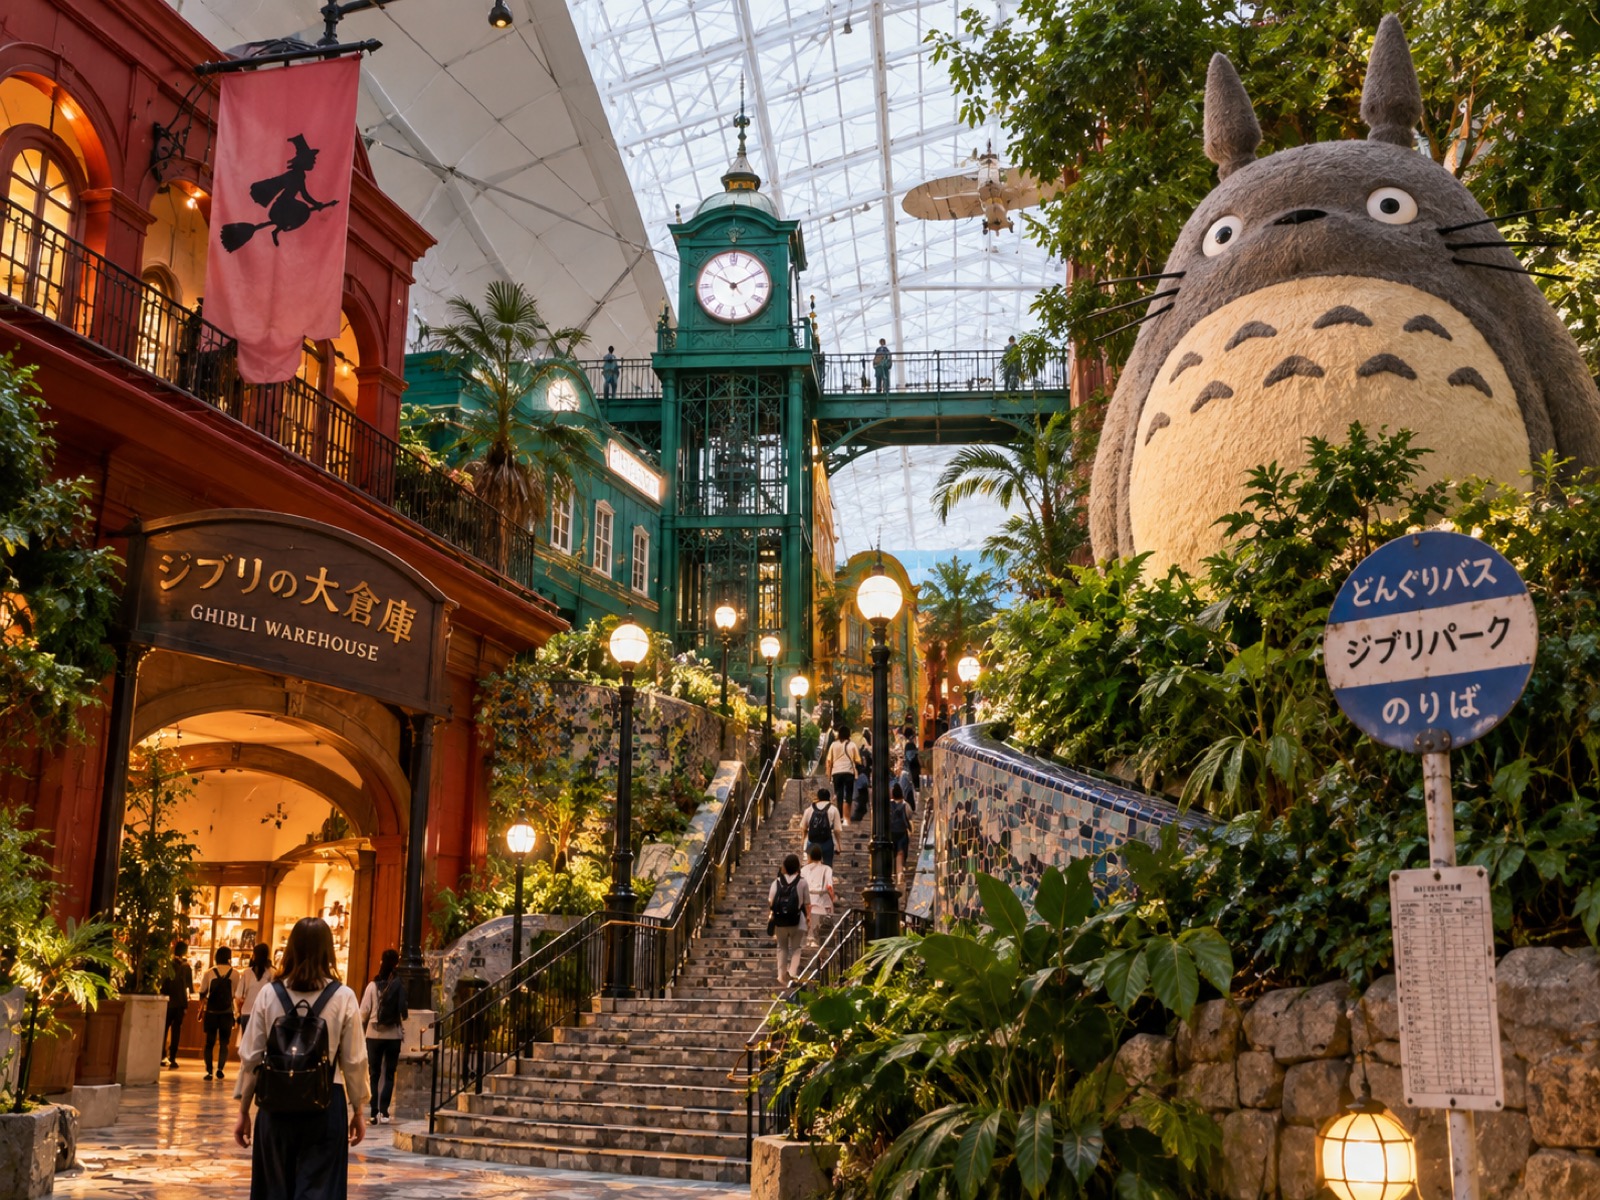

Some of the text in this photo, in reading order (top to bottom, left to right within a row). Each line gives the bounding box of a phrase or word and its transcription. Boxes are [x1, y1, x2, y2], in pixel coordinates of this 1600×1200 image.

[158, 553, 418, 645] ジブリの大倉庫
[1352, 557, 1498, 608] どんぐりバス
[190, 604, 379, 662] GHIBLI WAREHOUSE
[1346, 616, 1510, 669] ジブリパーク
[1382, 683, 1482, 725] のりば
